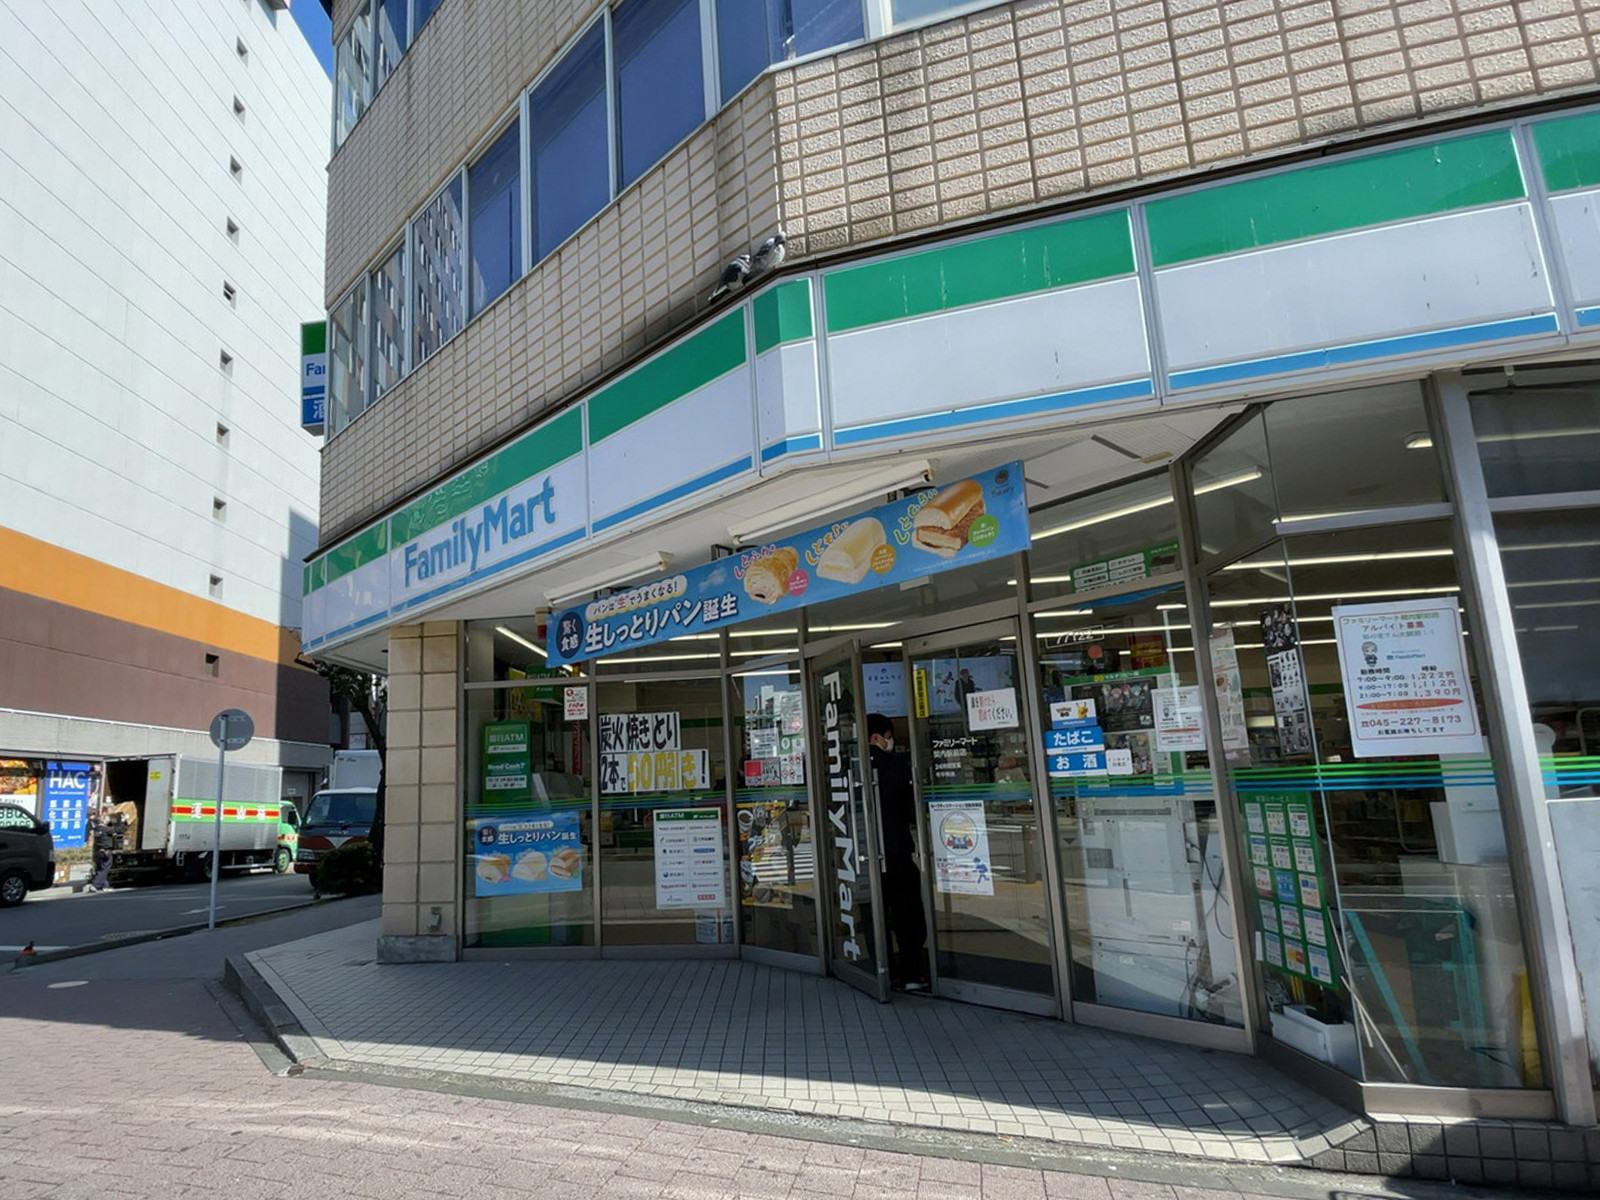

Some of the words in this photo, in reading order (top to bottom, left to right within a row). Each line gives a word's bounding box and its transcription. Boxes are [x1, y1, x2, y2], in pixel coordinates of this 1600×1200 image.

[404, 475, 556, 588] FamilyMart
[585, 593, 738, 653] 生しっとりパン誕生
[600, 713, 678, 751] 炭火焼きとり
[932, 737, 978, 748] ファミリーマート
[1053, 730, 1094, 746] たばこ
[49, 770, 86, 789] HAC
[601, 751, 707, 791] 2本で50円引き!
[1056, 754, 1098, 770] お酒
[822, 671, 861, 961] FamilyMart
